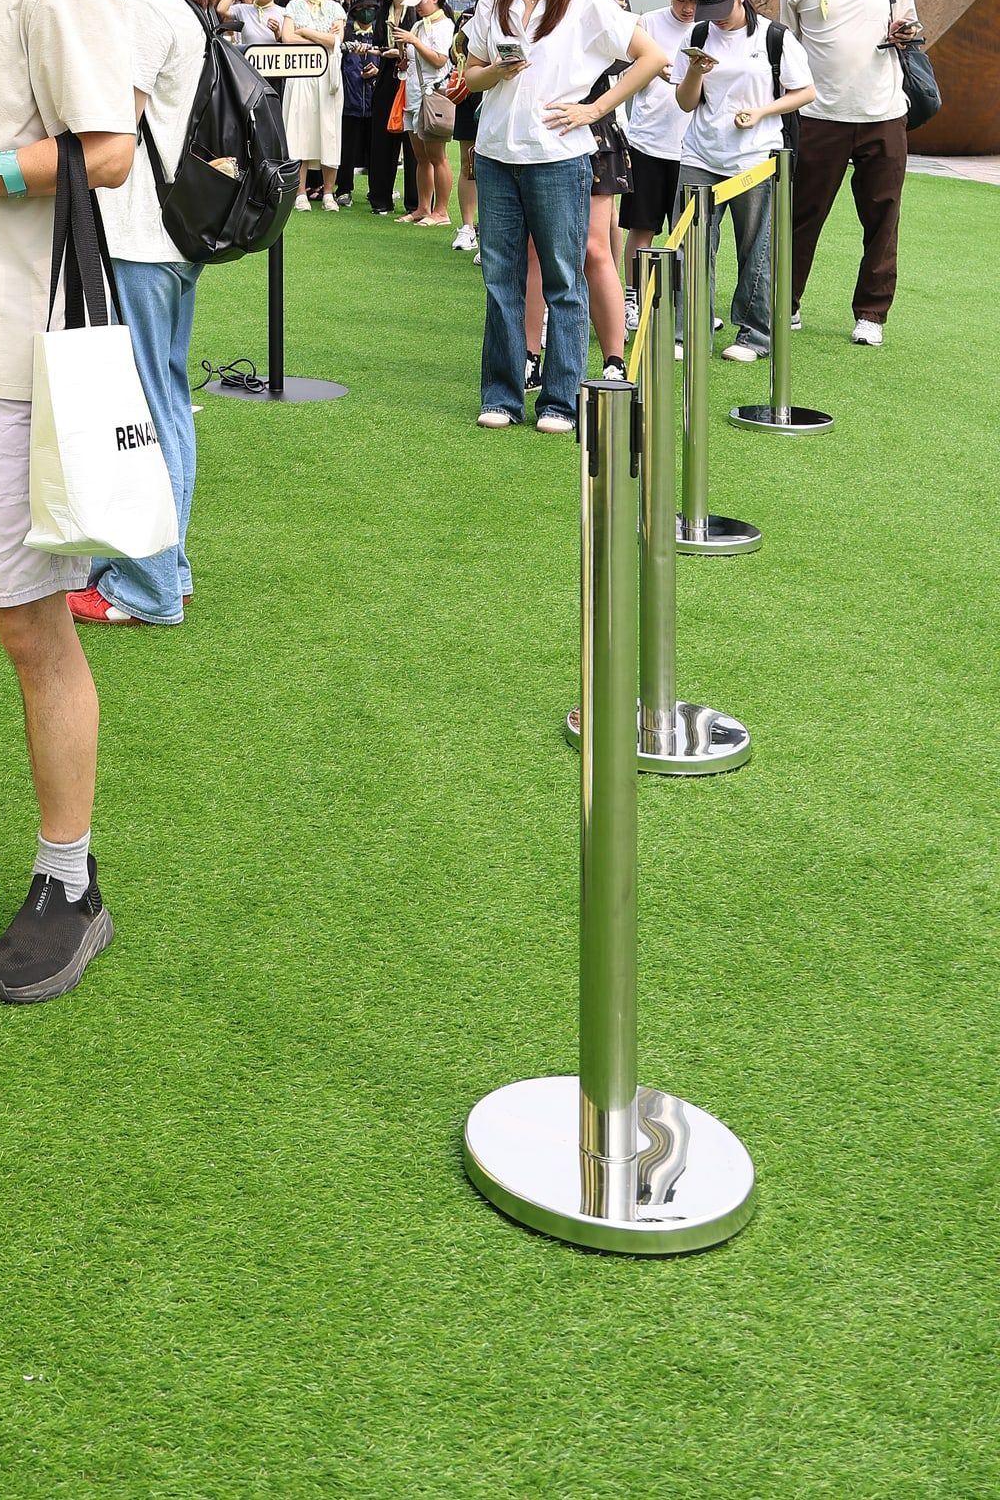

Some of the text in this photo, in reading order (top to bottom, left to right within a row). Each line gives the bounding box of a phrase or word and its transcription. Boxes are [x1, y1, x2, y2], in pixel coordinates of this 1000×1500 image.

[248, 54, 322, 69] OLIVE BETTER
[115, 422, 159, 451] RENAU
